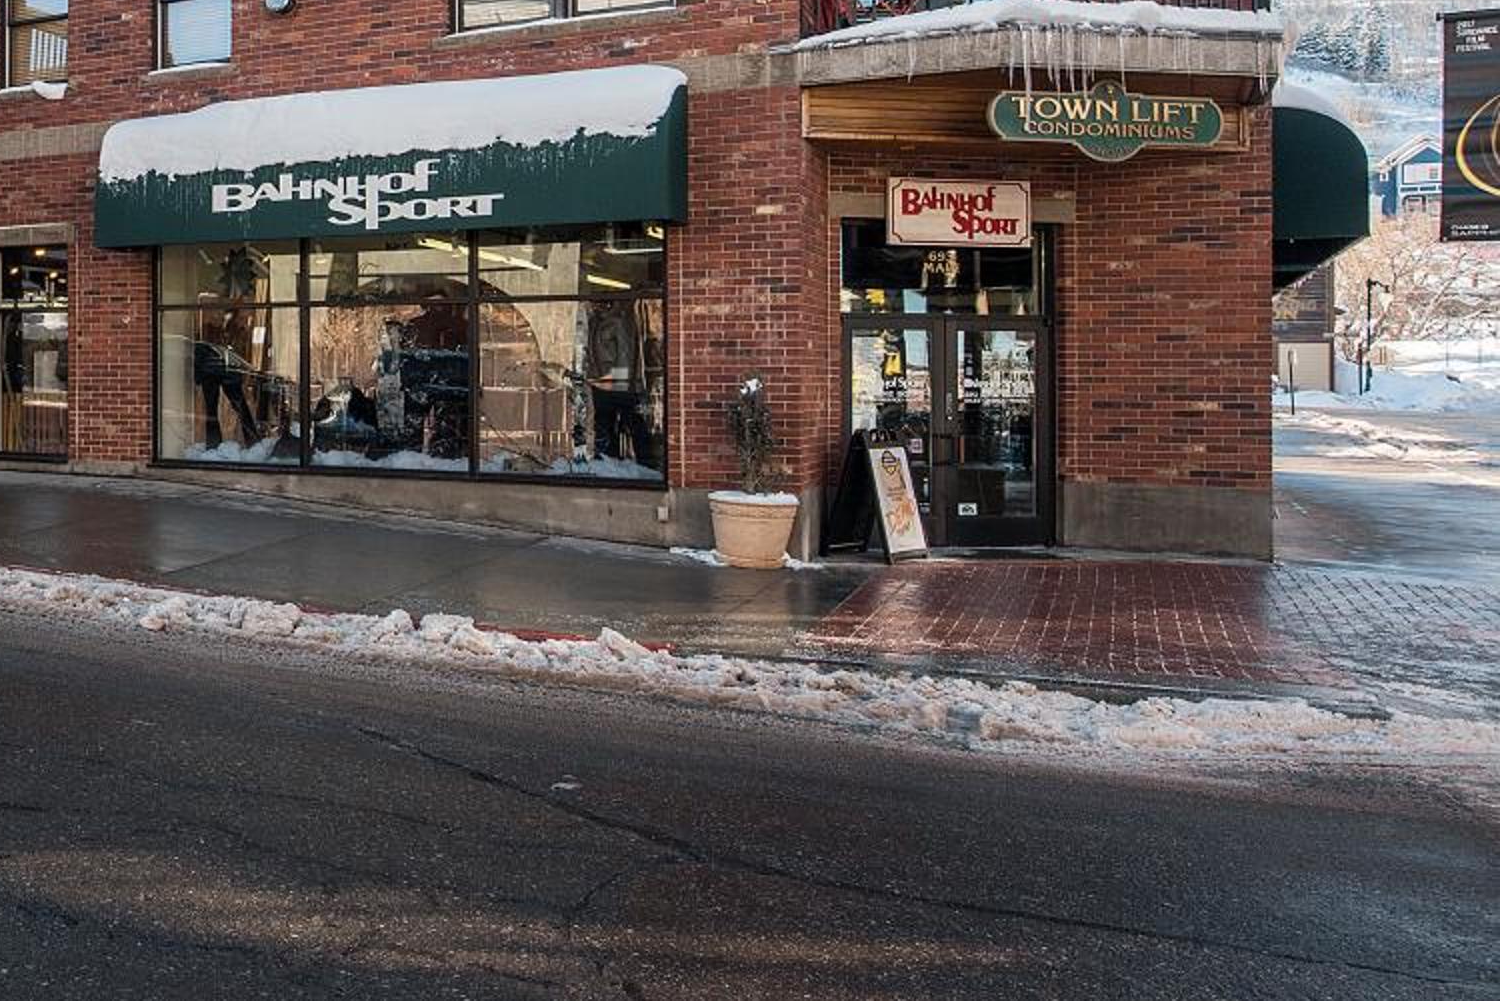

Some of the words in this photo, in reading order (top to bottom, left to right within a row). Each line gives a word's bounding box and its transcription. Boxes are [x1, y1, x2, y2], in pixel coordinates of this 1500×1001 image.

[1011, 96, 1118, 121] TOWN
[1132, 100, 1204, 124] LIFT
[1026, 121, 1195, 139] CONDOMINIUMS
